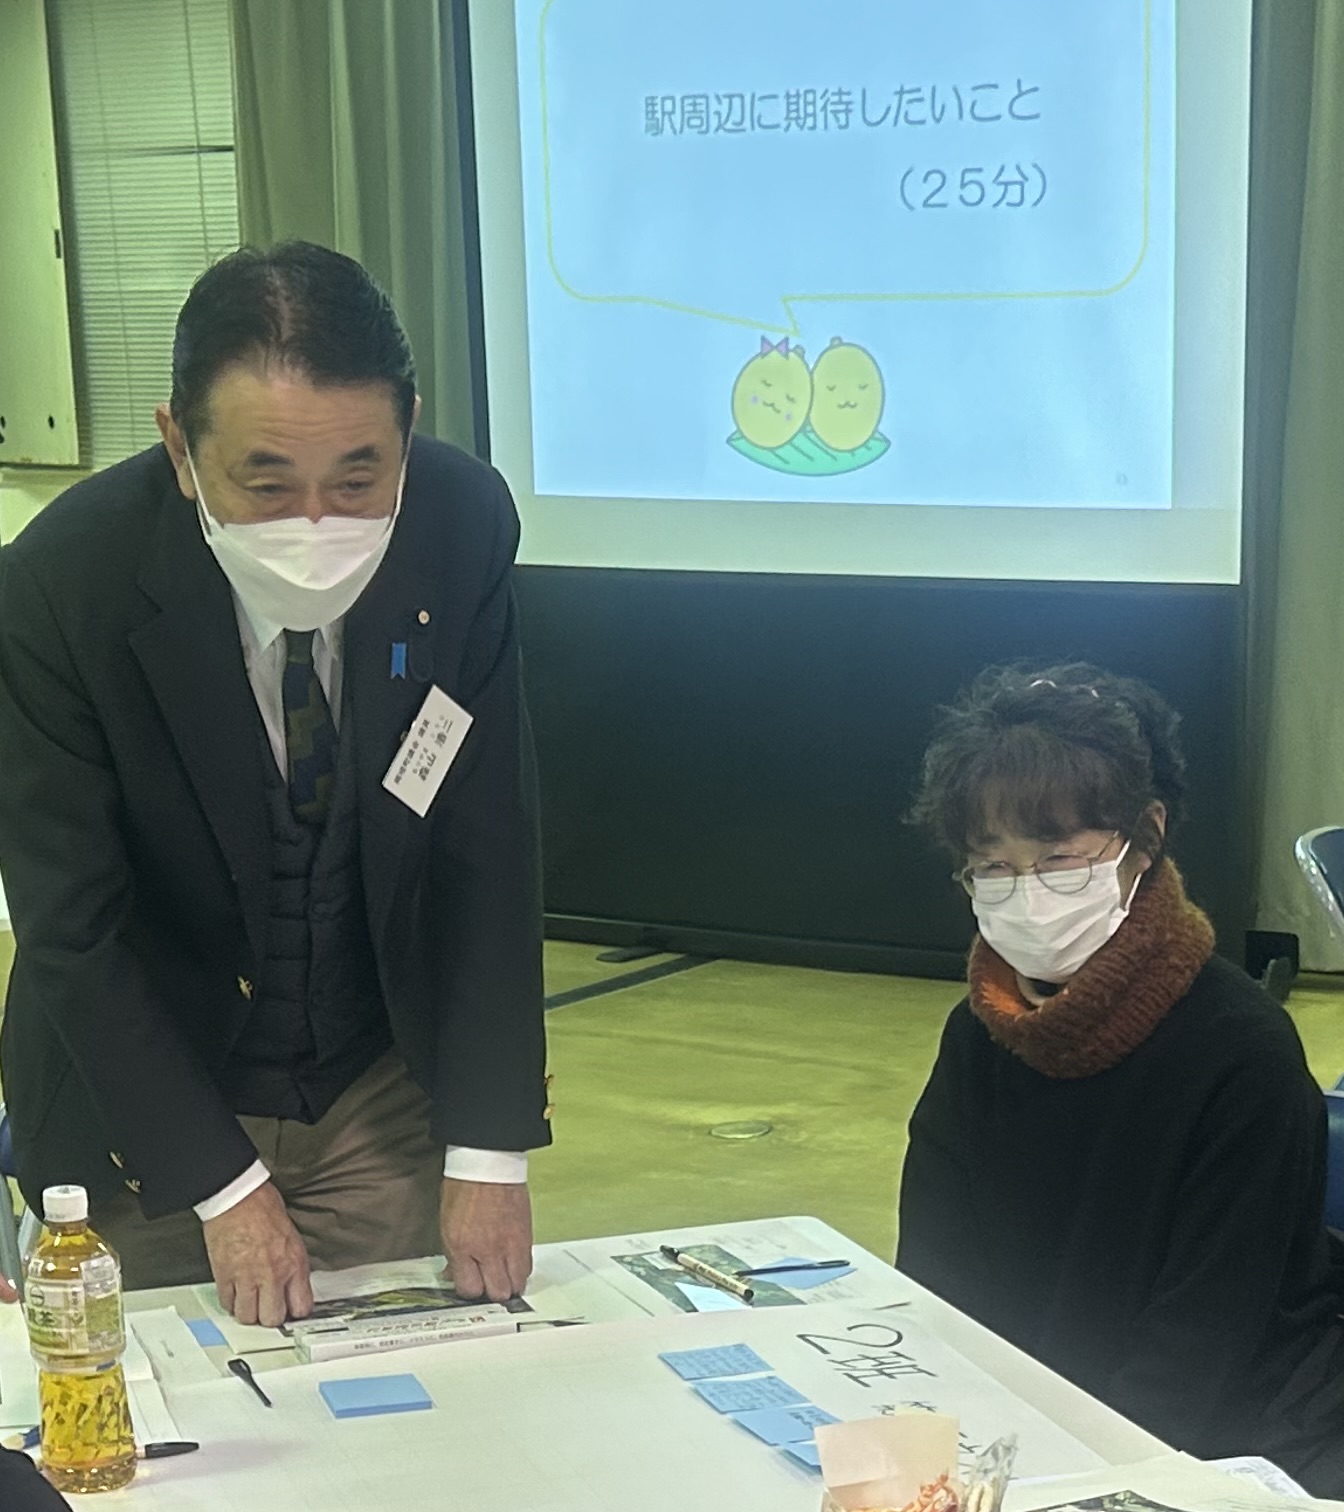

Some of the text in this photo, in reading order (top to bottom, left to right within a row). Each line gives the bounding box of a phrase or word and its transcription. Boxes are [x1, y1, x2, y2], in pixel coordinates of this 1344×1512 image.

[643, 78, 1043, 137] 駅周辺に期待したいこと
[899, 163, 1048, 212] (25分)
